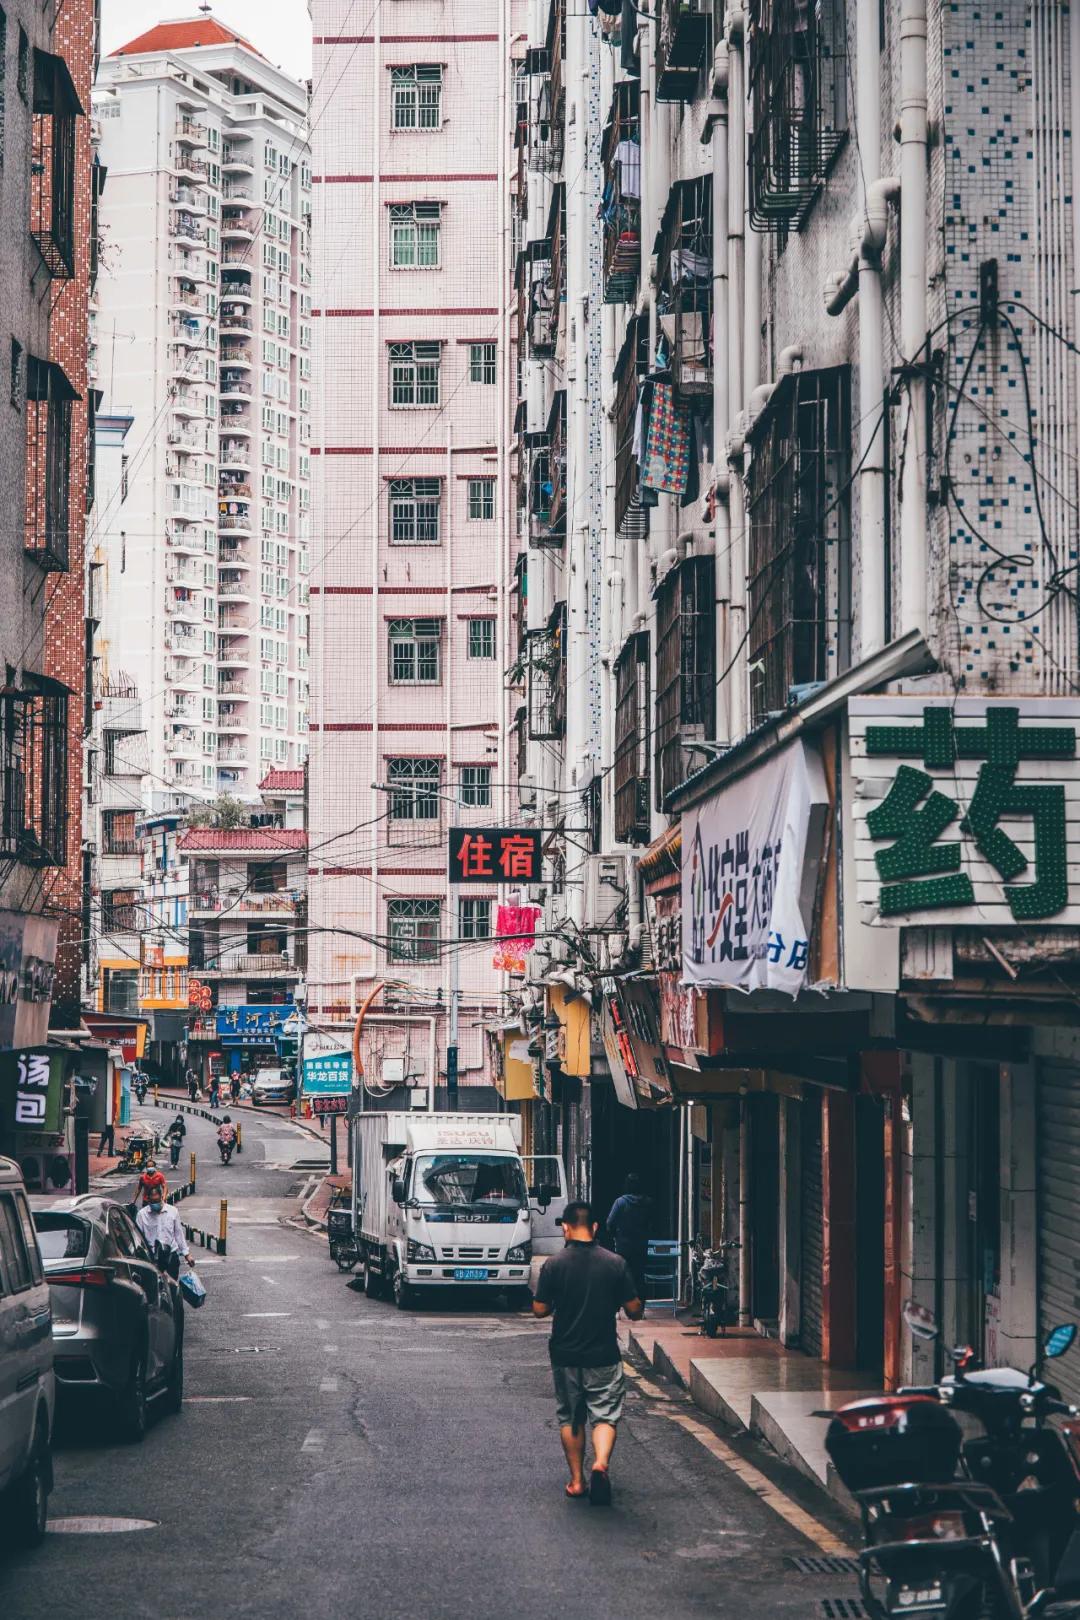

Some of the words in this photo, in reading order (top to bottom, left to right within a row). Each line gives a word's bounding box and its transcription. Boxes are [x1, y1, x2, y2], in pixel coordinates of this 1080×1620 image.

[865, 706, 1077, 920] 药
[456, 833, 535, 878] 住宿
[15, 1054, 50, 1124] 汤包
[306, 1071, 348, 1082] 华龙百货
[454, 1215, 490, 1223] ISUZU
